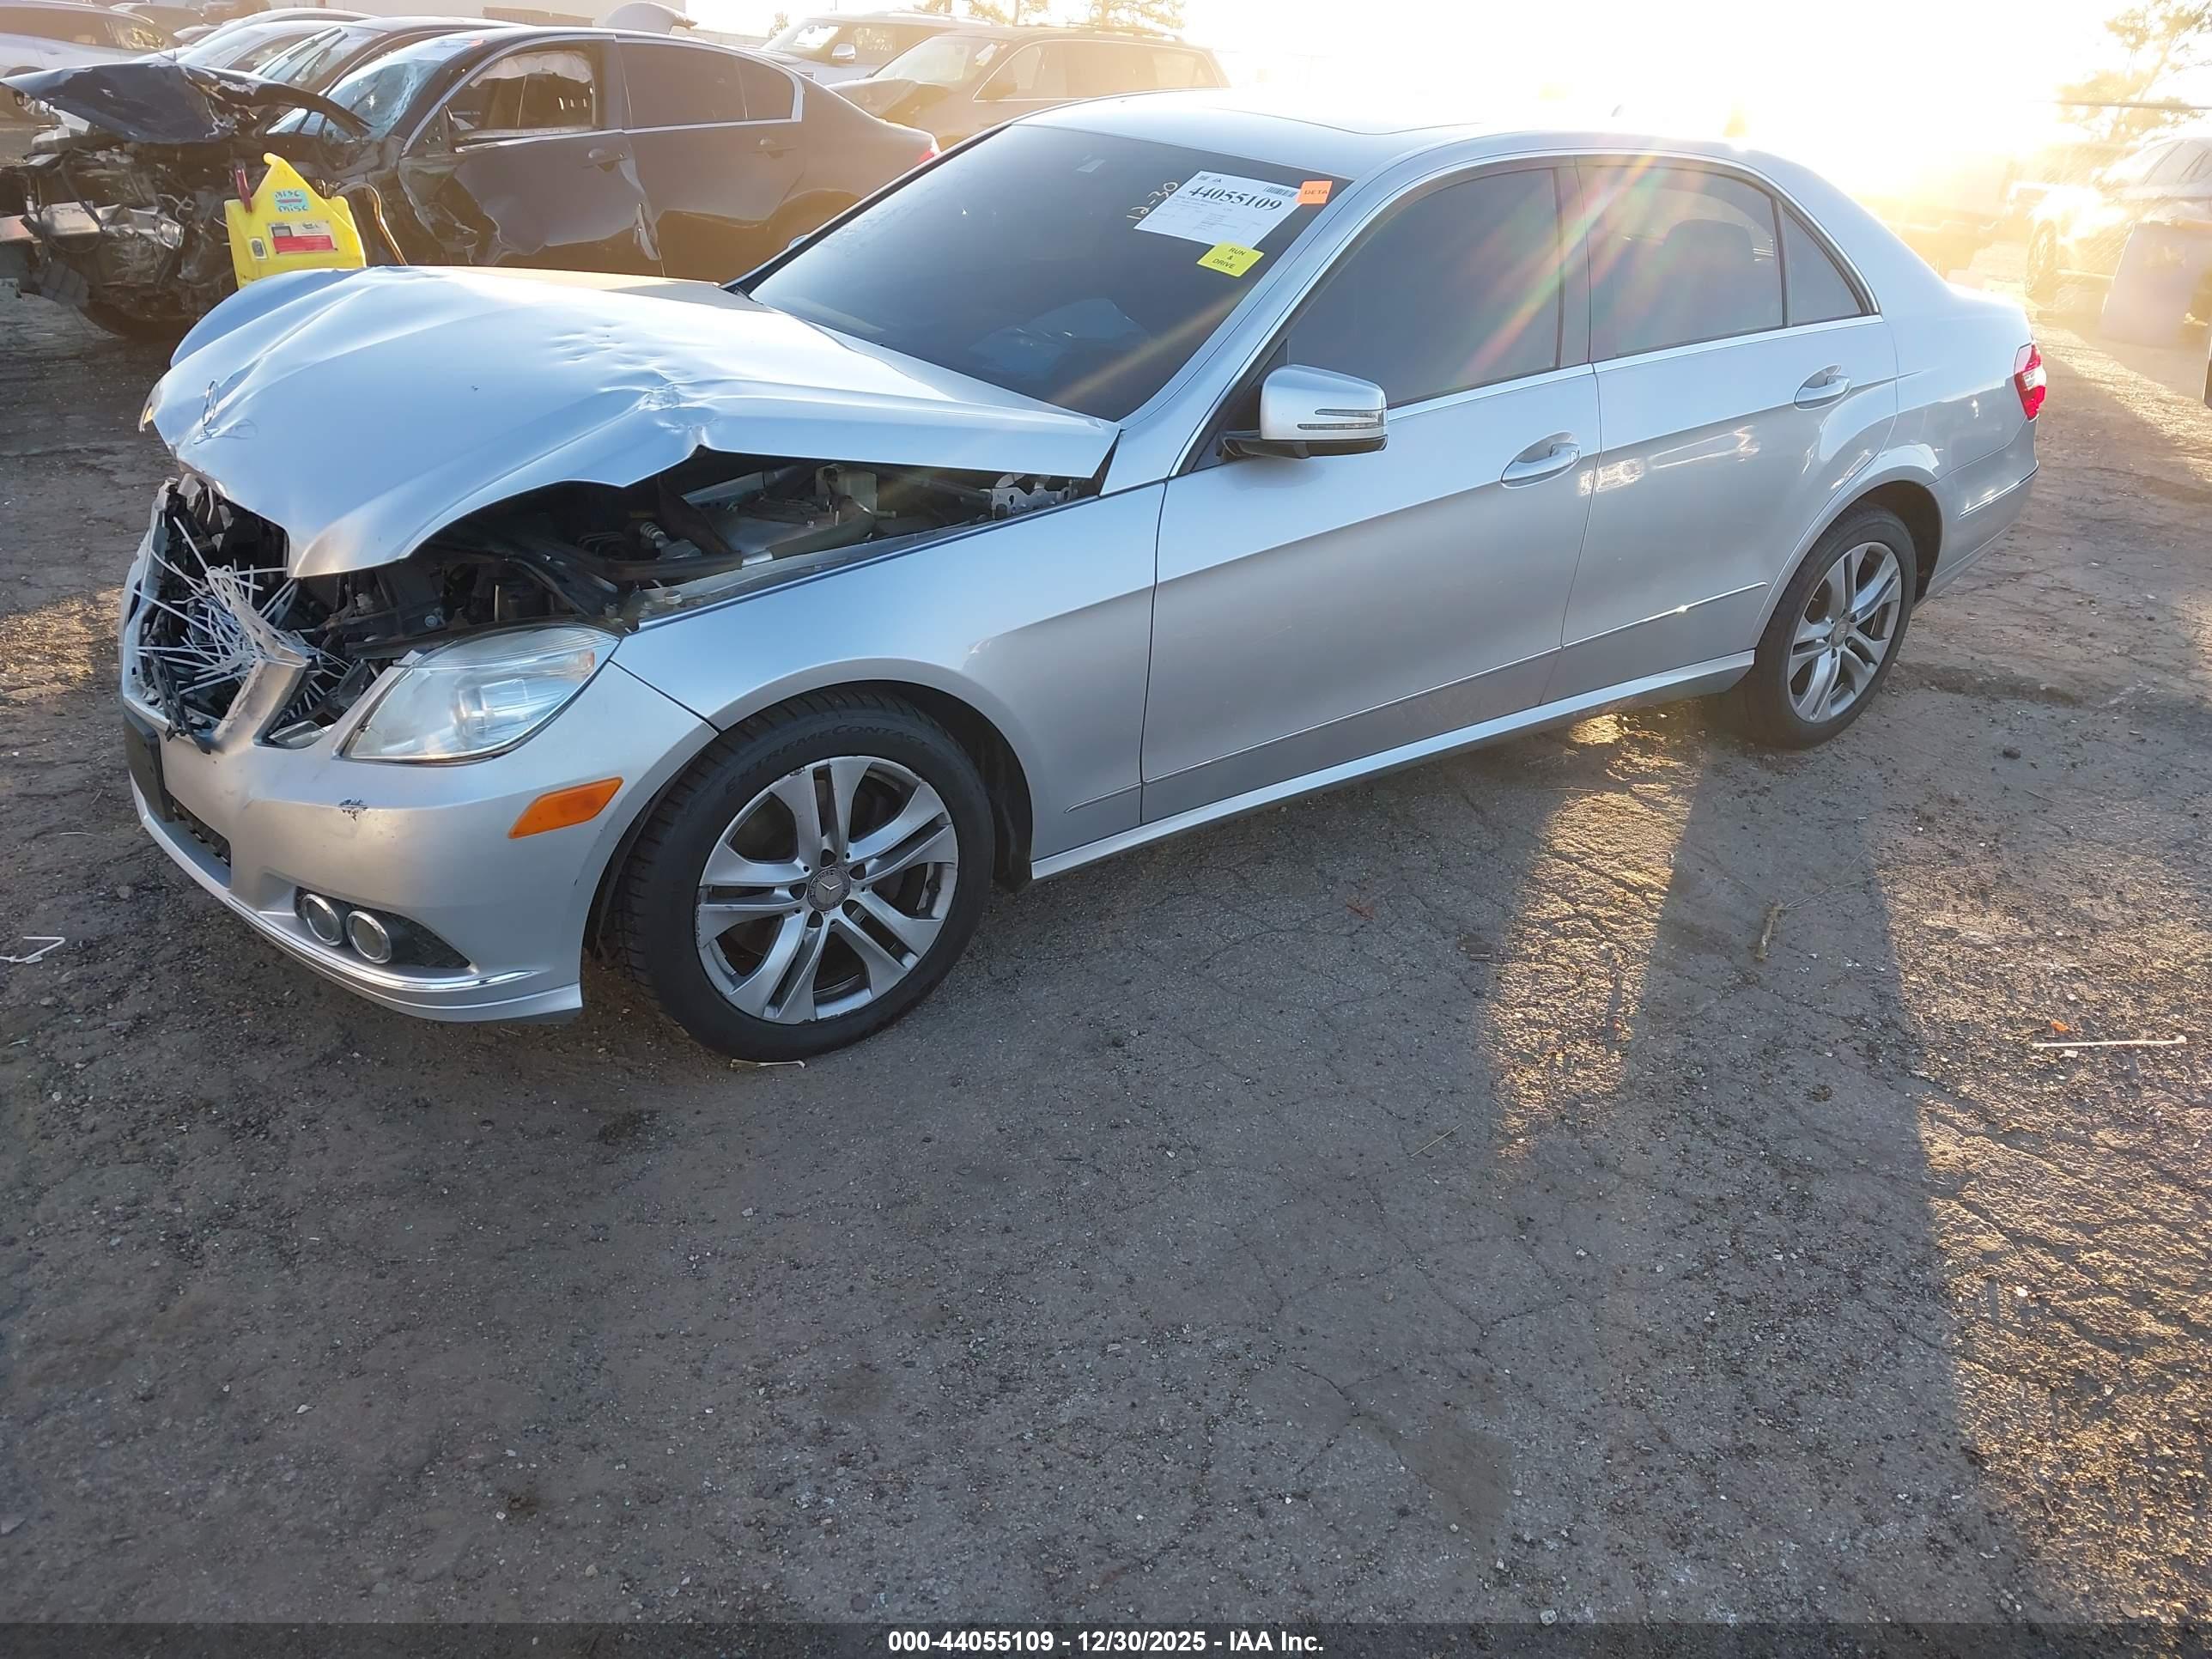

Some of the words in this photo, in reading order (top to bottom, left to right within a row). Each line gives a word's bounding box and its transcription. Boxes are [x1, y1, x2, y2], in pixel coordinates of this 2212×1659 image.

[1188, 185, 1283, 211] 44055109
[1229, 247, 1247, 256] RUN
[1212, 258, 1237, 270] DRIVE
